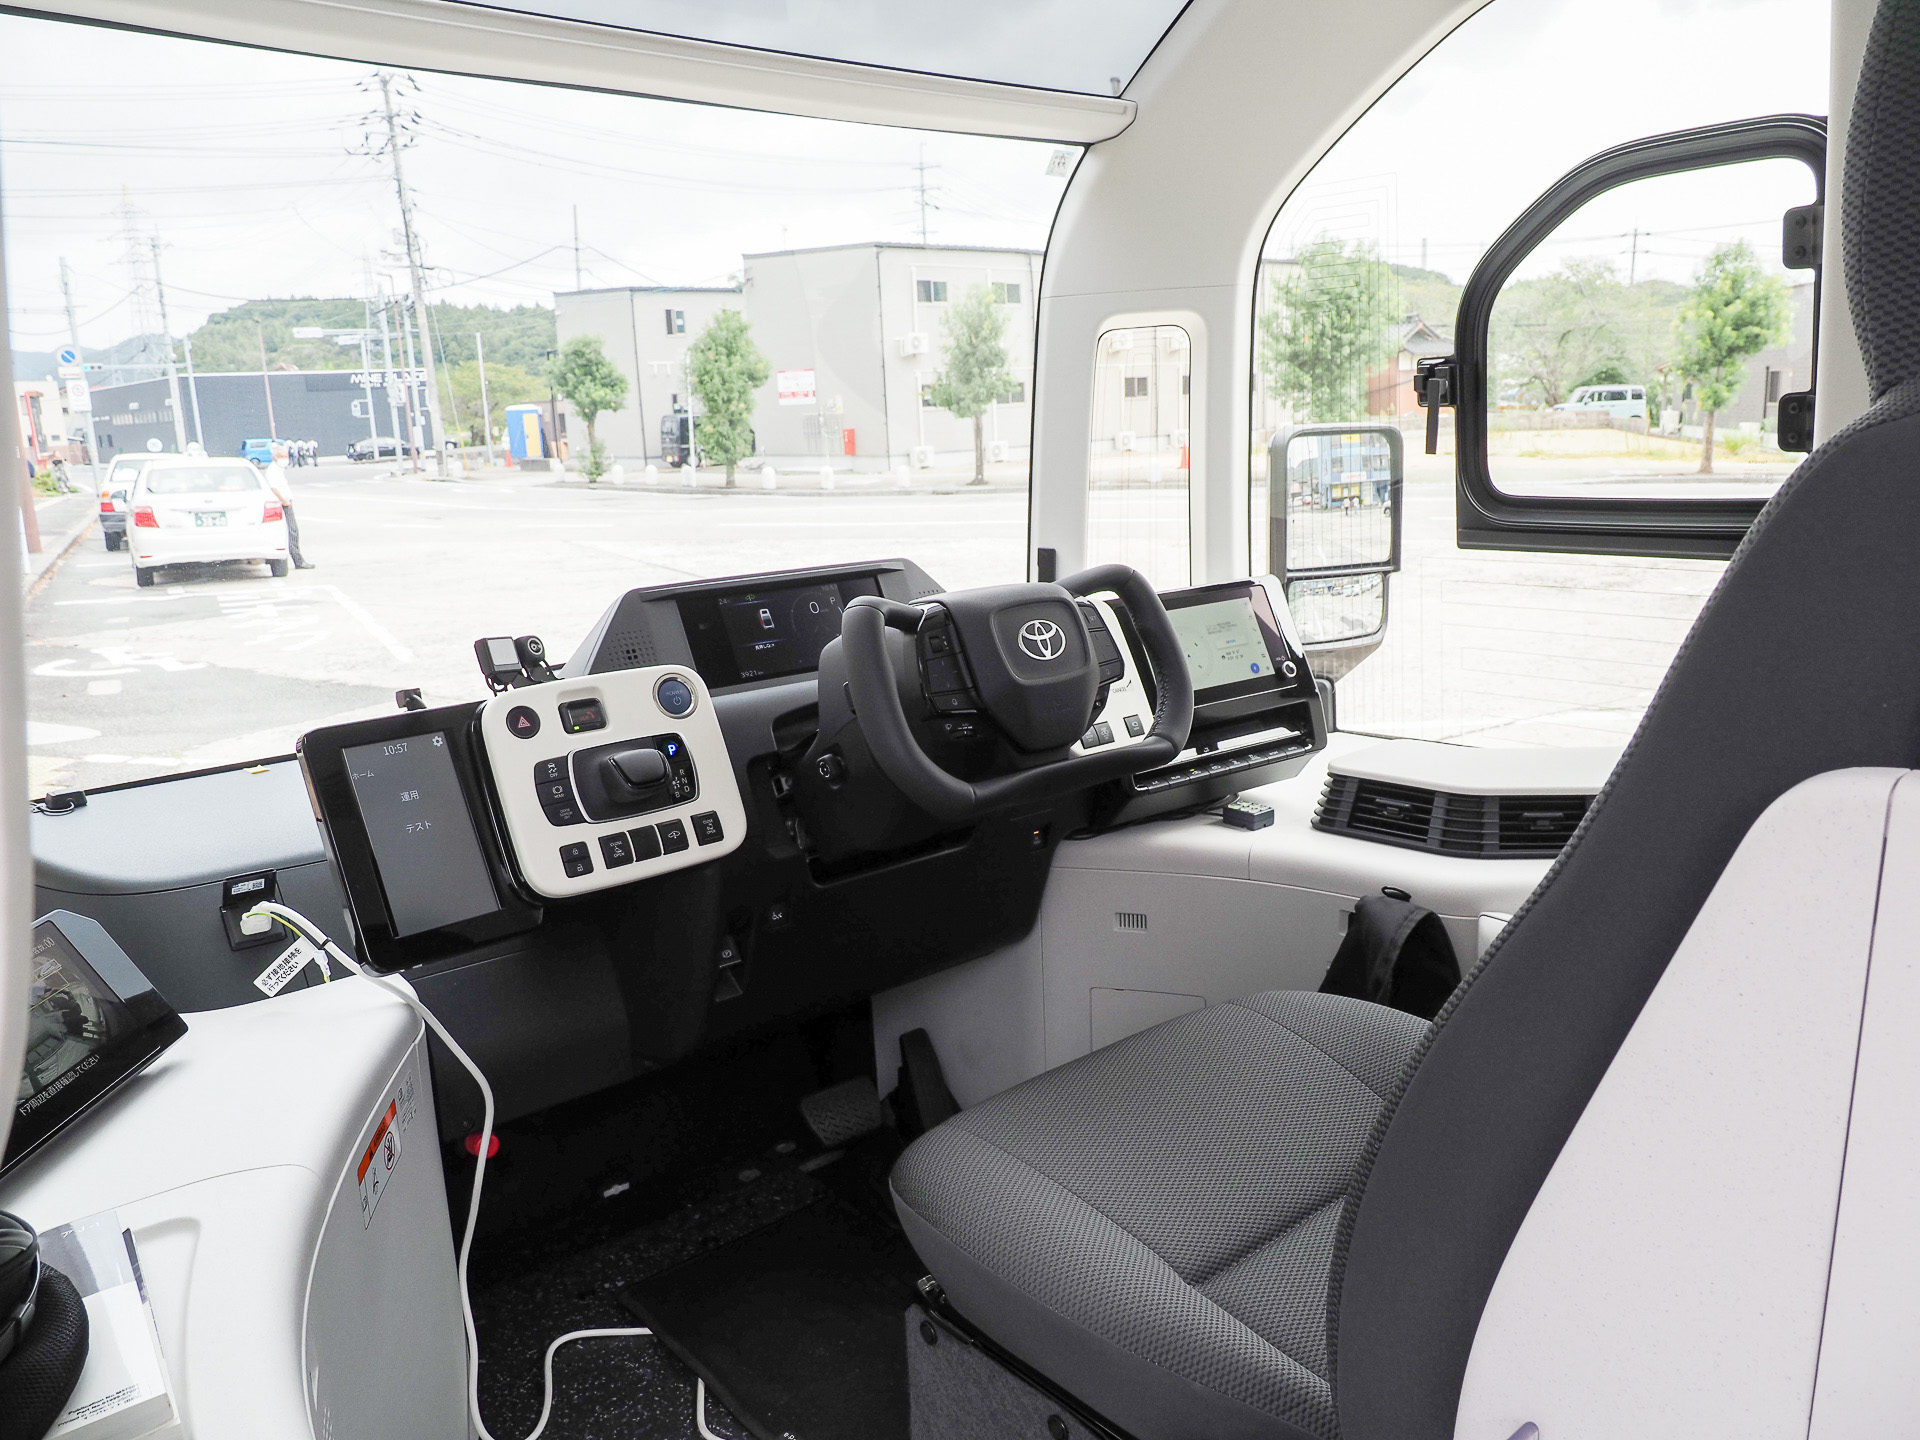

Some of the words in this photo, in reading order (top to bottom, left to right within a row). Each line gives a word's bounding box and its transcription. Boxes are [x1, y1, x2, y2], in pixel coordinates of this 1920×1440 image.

[809, 601, 819, 614] 0
[383, 743, 408, 756] 10:57
[668, 744, 677, 756] P
[683, 785, 690, 793] D
[400, 790, 420, 802] 運用
[406, 821, 431, 833] テスト
[267, 961, 299, 992] 行ってください
[68, 1398, 104, 1415] Publication
[76, 1407, 90, 1416] Part
